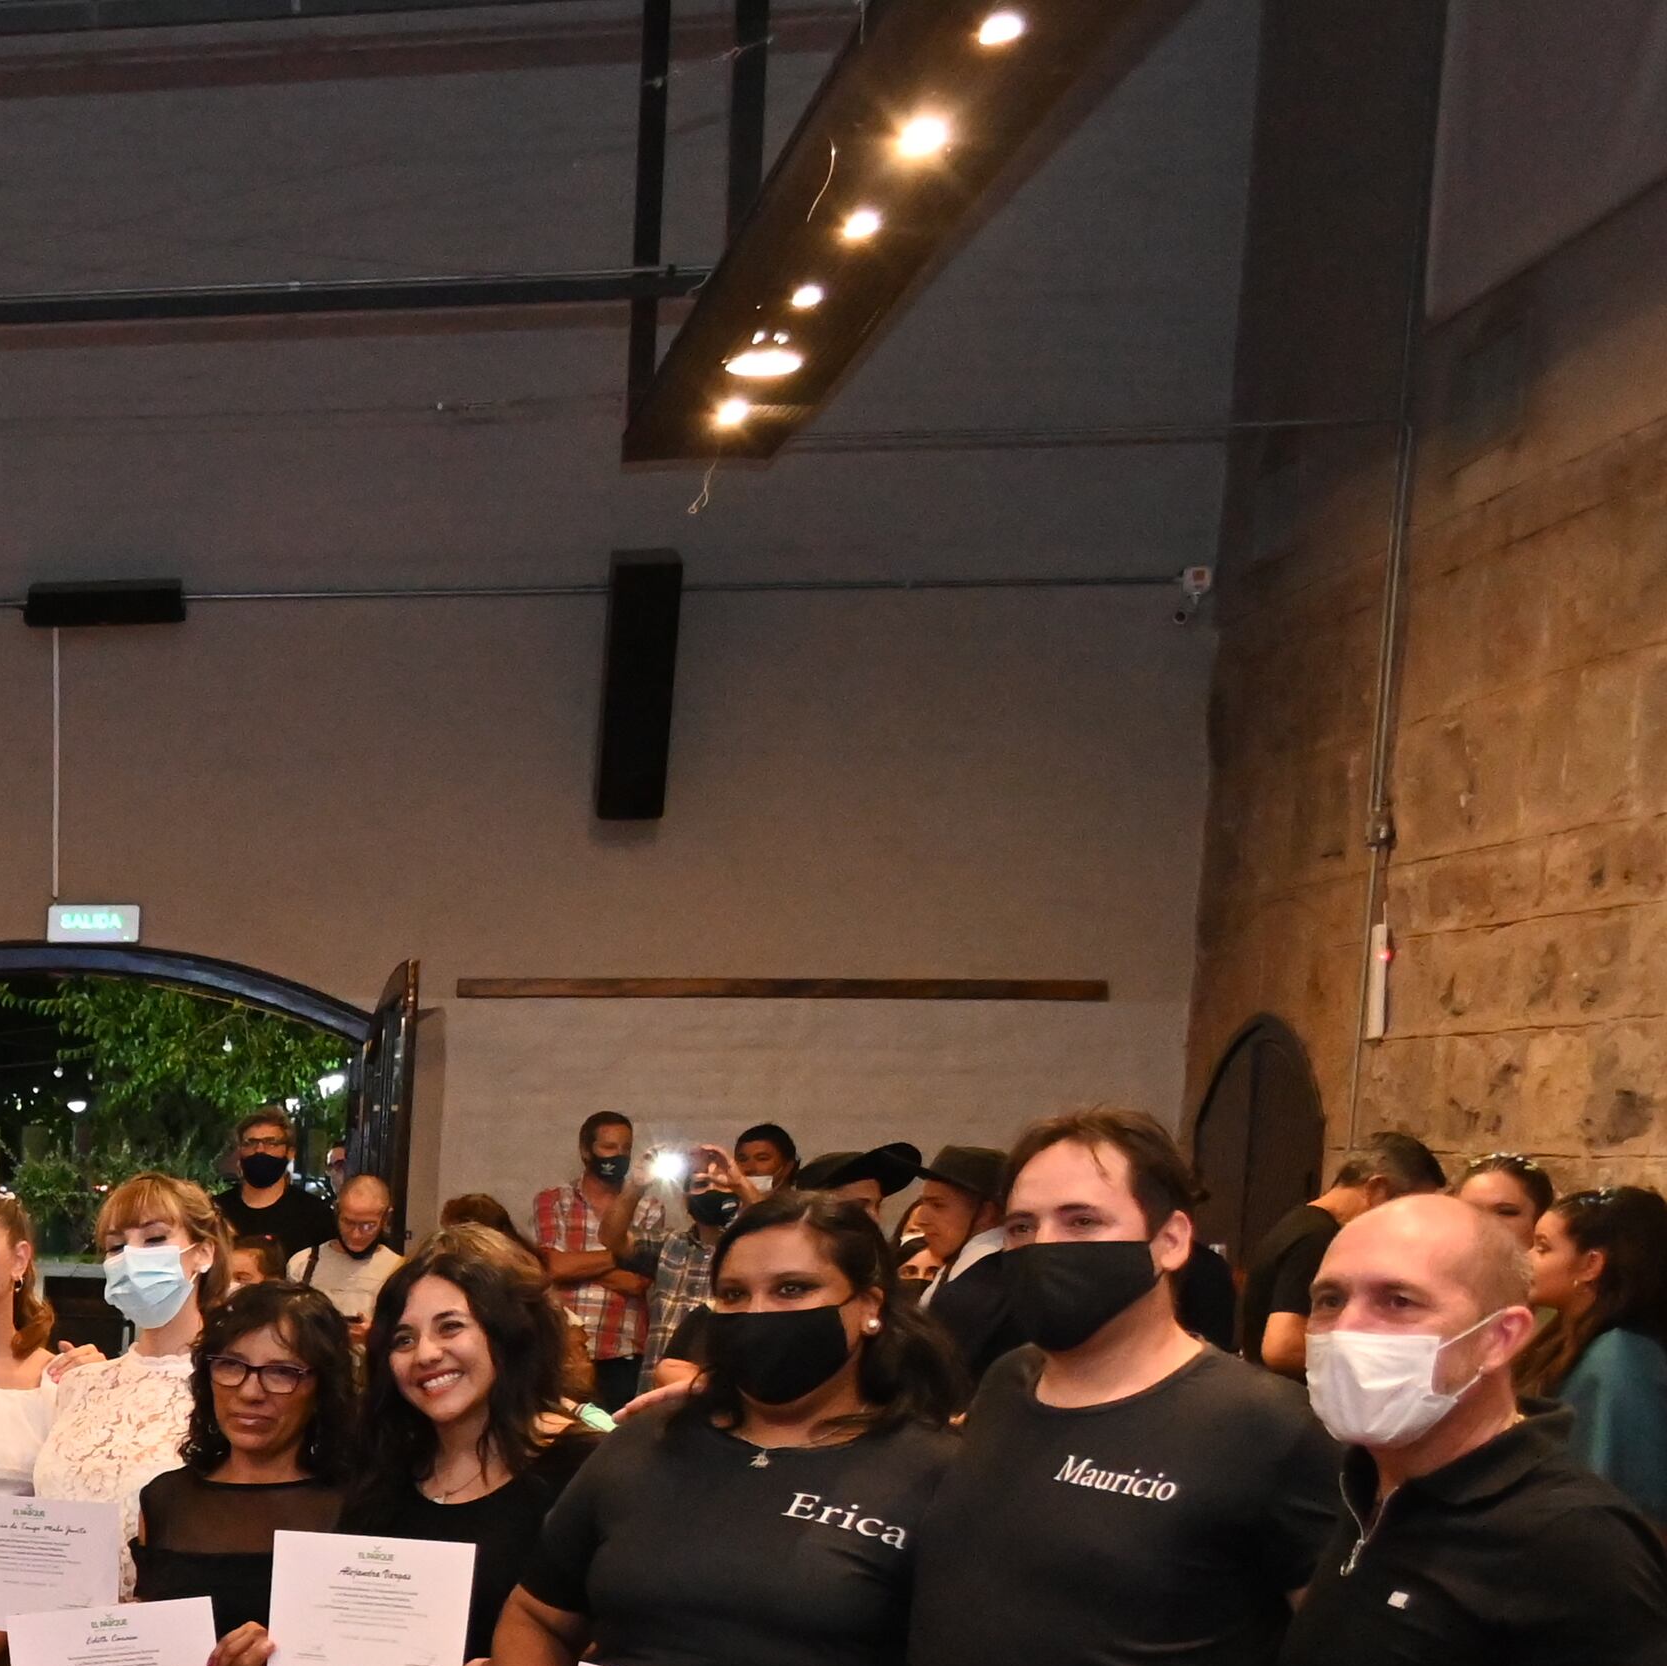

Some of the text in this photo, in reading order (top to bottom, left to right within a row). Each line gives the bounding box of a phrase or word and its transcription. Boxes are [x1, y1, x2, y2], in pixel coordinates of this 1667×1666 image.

[60, 913, 123, 929] SALIDA
[1052, 1453, 1179, 1502] Mauricio
[780, 1490, 909, 1550] Erica
[366, 1553, 395, 1562] PARQUE
